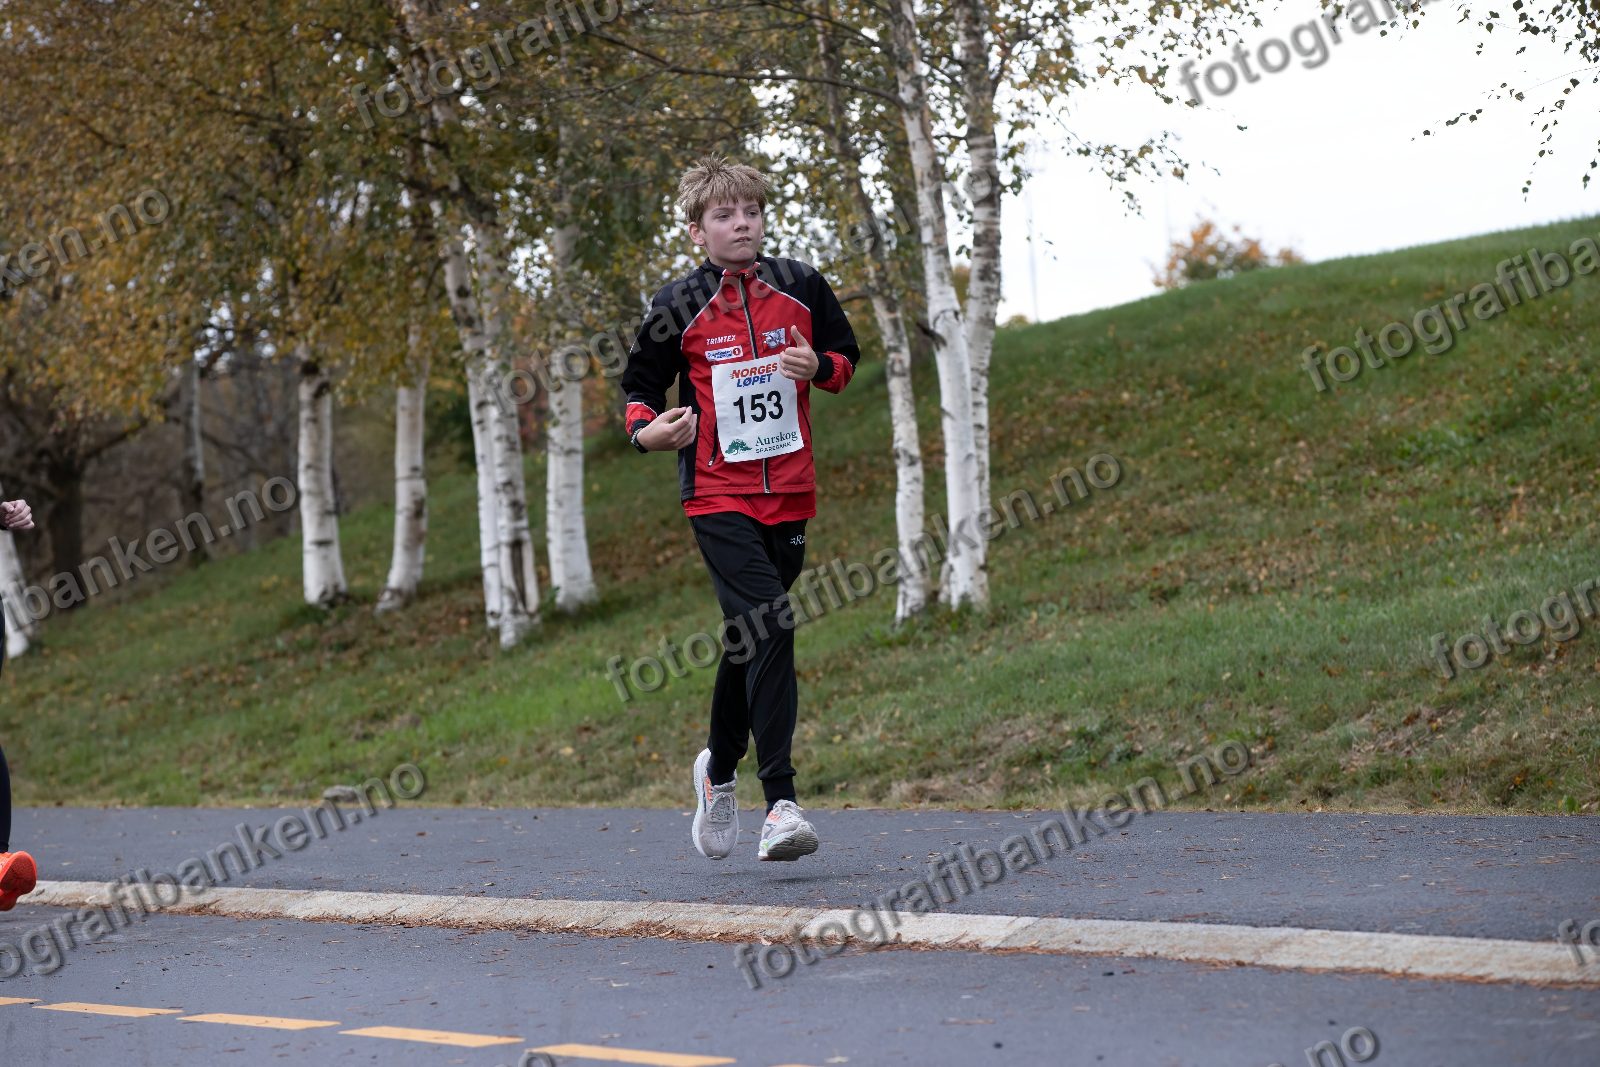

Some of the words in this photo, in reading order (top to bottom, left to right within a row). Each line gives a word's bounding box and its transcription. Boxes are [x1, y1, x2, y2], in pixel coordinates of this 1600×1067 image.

[706, 334, 736, 346] TRIMTEX
[731, 363, 778, 379] NORGES
[736, 373, 773, 388] LØPET
[733, 390, 784, 424] 153
[755, 431, 798, 447] Aurskog
